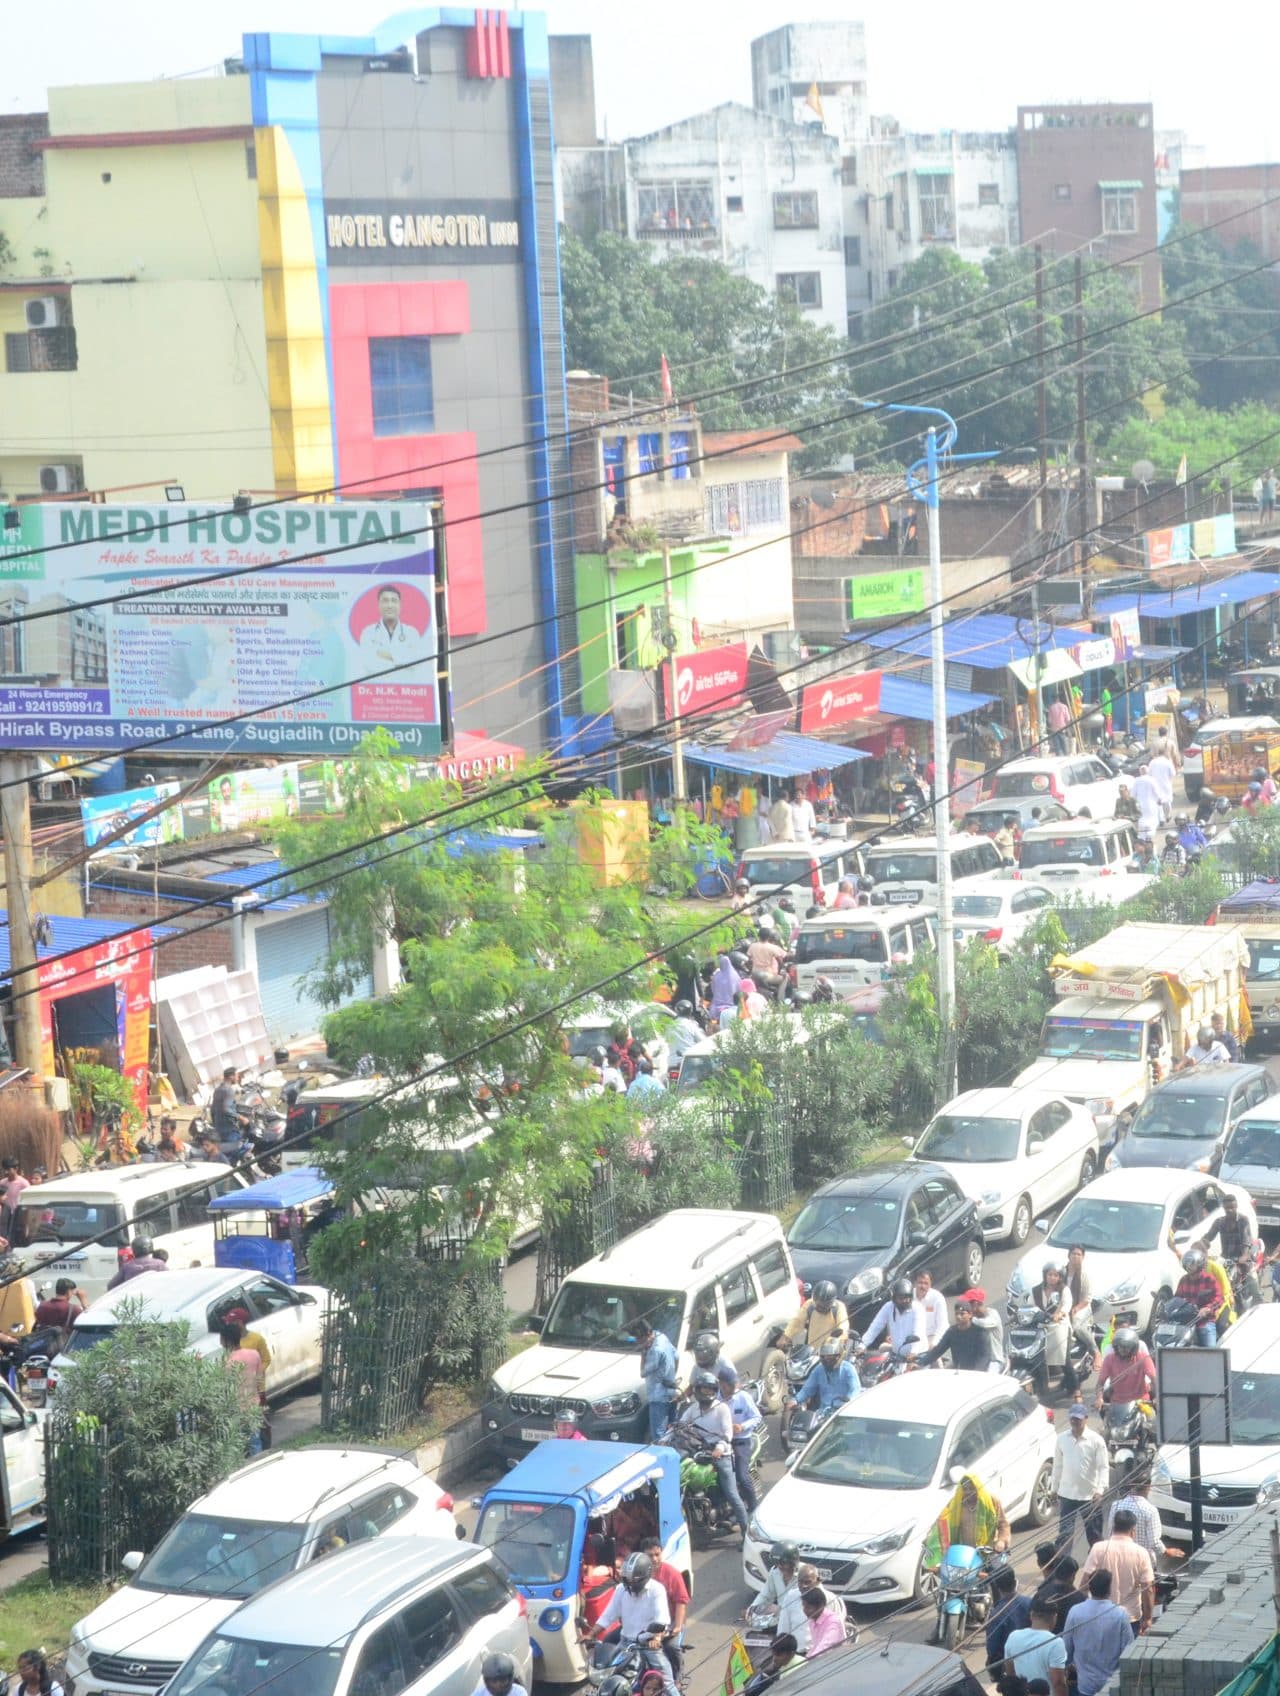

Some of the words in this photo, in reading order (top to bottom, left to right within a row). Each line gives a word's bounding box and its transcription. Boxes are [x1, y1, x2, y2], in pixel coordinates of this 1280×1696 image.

[327, 214, 386, 248] HOTEL
[389, 214, 488, 247] GANGOTRI
[60, 509, 169, 544] MEDI
[187, 508, 416, 546] HOSPITAL
[97, 548, 139, 567] Aapke
[200, 549, 220, 564] Ka
[256, 579, 277, 588] Care
[117, 603, 177, 614] TREATMENT
[179, 604, 223, 615] FACILITY
[225, 605, 281, 616] AVAILABLE
[695, 674, 714, 692] airtel
[8, 690, 18, 699] 24
[19, 690, 43, 699] Hours
[44, 690, 89, 701] Emergency
[401, 688, 428, 697] Modi
[128, 707, 135, 717] A
[138, 707, 160, 718] Well
[163, 708, 202, 718] trusted
[206, 709, 235, 718] name
[281, 709, 294, 719] 15
[296, 710, 328, 721] years
[0, 722, 45, 737] Hirak
[50, 723, 114, 741] Bypass
[244, 726, 324, 744] Sugiadih
